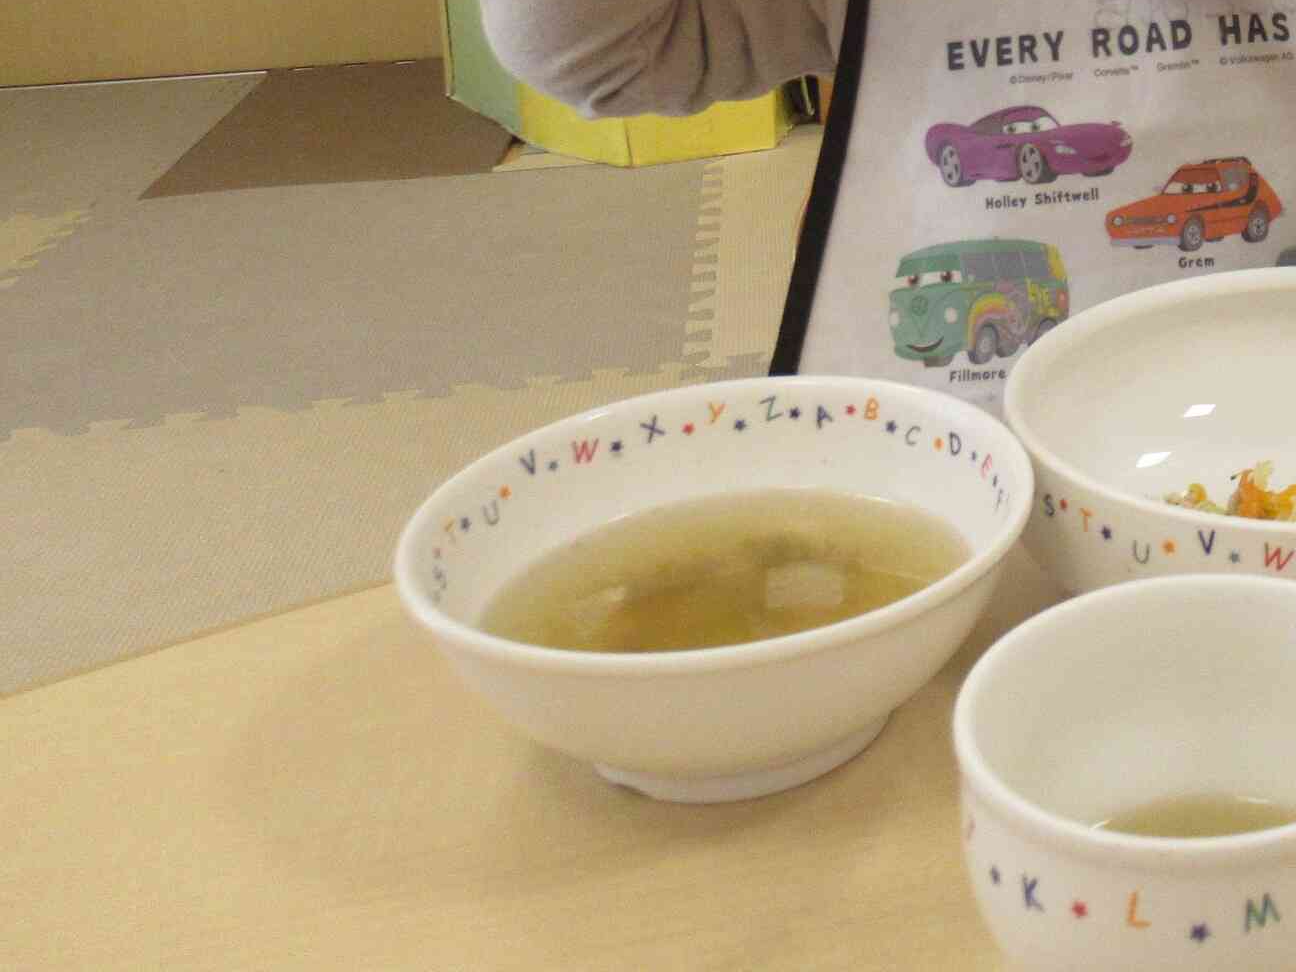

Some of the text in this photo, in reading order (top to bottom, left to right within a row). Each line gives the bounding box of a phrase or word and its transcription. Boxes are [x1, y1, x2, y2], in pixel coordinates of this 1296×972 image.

[947, 30, 1063, 71] EVERY
[1091, 19, 1193, 58] ROAD
[1218, 11, 1291, 46] HAS
[985, 187, 1099, 209] Holley Shiftwell
[949, 368, 1007, 383] Fillmore
[483, 499, 500, 526] U
[519, 449, 536, 475] V
[571, 438, 600, 463] W
[639, 415, 666, 444] X
[706, 401, 727, 424] Y
[815, 405, 834, 429] A
[863, 398, 879, 420] B
[904, 425, 922, 446] C
[949, 432, 962, 456] D
[1043, 493, 1055, 517] S
[1080, 507, 1093, 532] T
[1132, 540, 1151, 565] U
[1198, 528, 1216, 555] V
[1264, 542, 1295, 571] W
[1022, 873, 1044, 912] K
[1126, 890, 1152, 929] L
[1244, 892, 1282, 933] M
